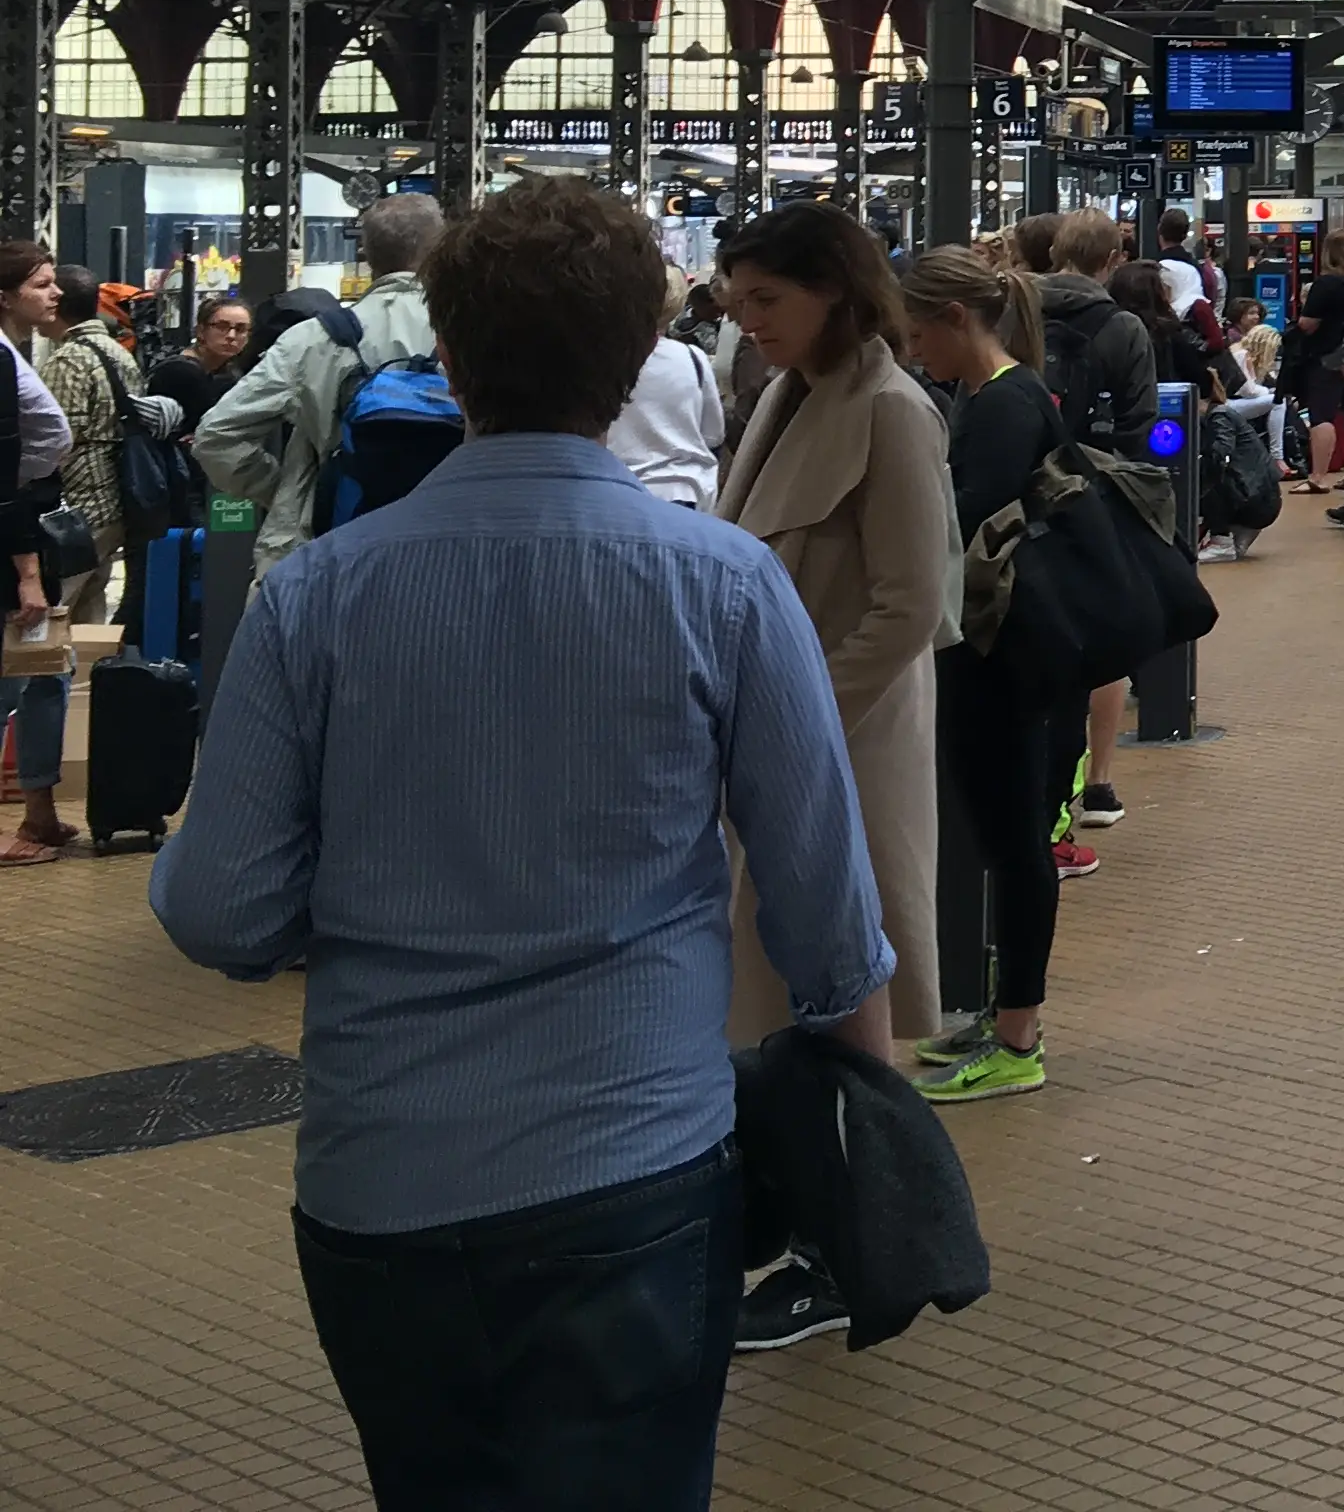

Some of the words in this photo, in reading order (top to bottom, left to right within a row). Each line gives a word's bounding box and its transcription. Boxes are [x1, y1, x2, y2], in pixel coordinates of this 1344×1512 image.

[884, 99, 901, 121] 5
[993, 93, 1011, 116] 6
[889, 185, 912, 199] 80
[666, 194, 684, 215] C
[212, 499, 253, 510] Check
